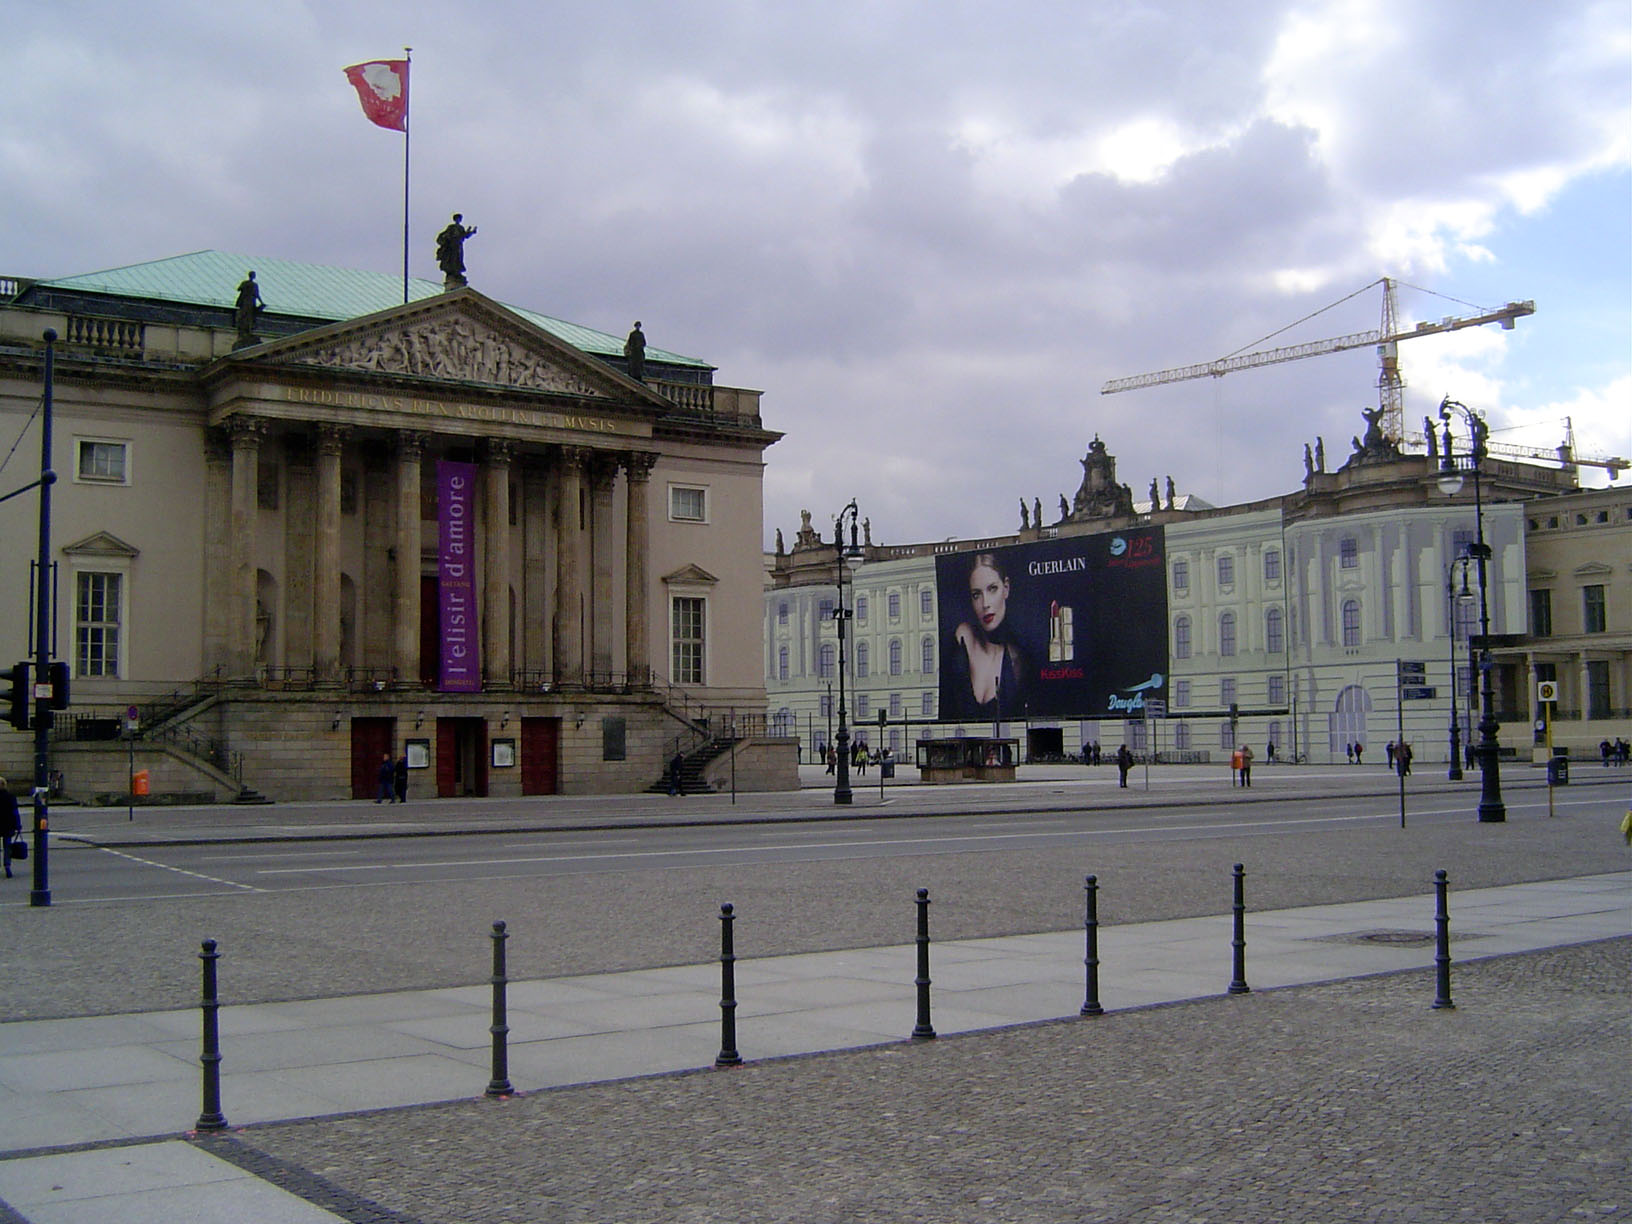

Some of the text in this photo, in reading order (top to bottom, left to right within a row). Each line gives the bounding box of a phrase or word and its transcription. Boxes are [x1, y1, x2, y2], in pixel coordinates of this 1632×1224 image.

[411, 400, 448, 416] REX
[455, 405, 536, 423] APOLLINI
[563, 415, 616, 431] MVSIS
[444, 475, 468, 673] l'elisir d'amore
[1107, 692, 1146, 714] Dougla
